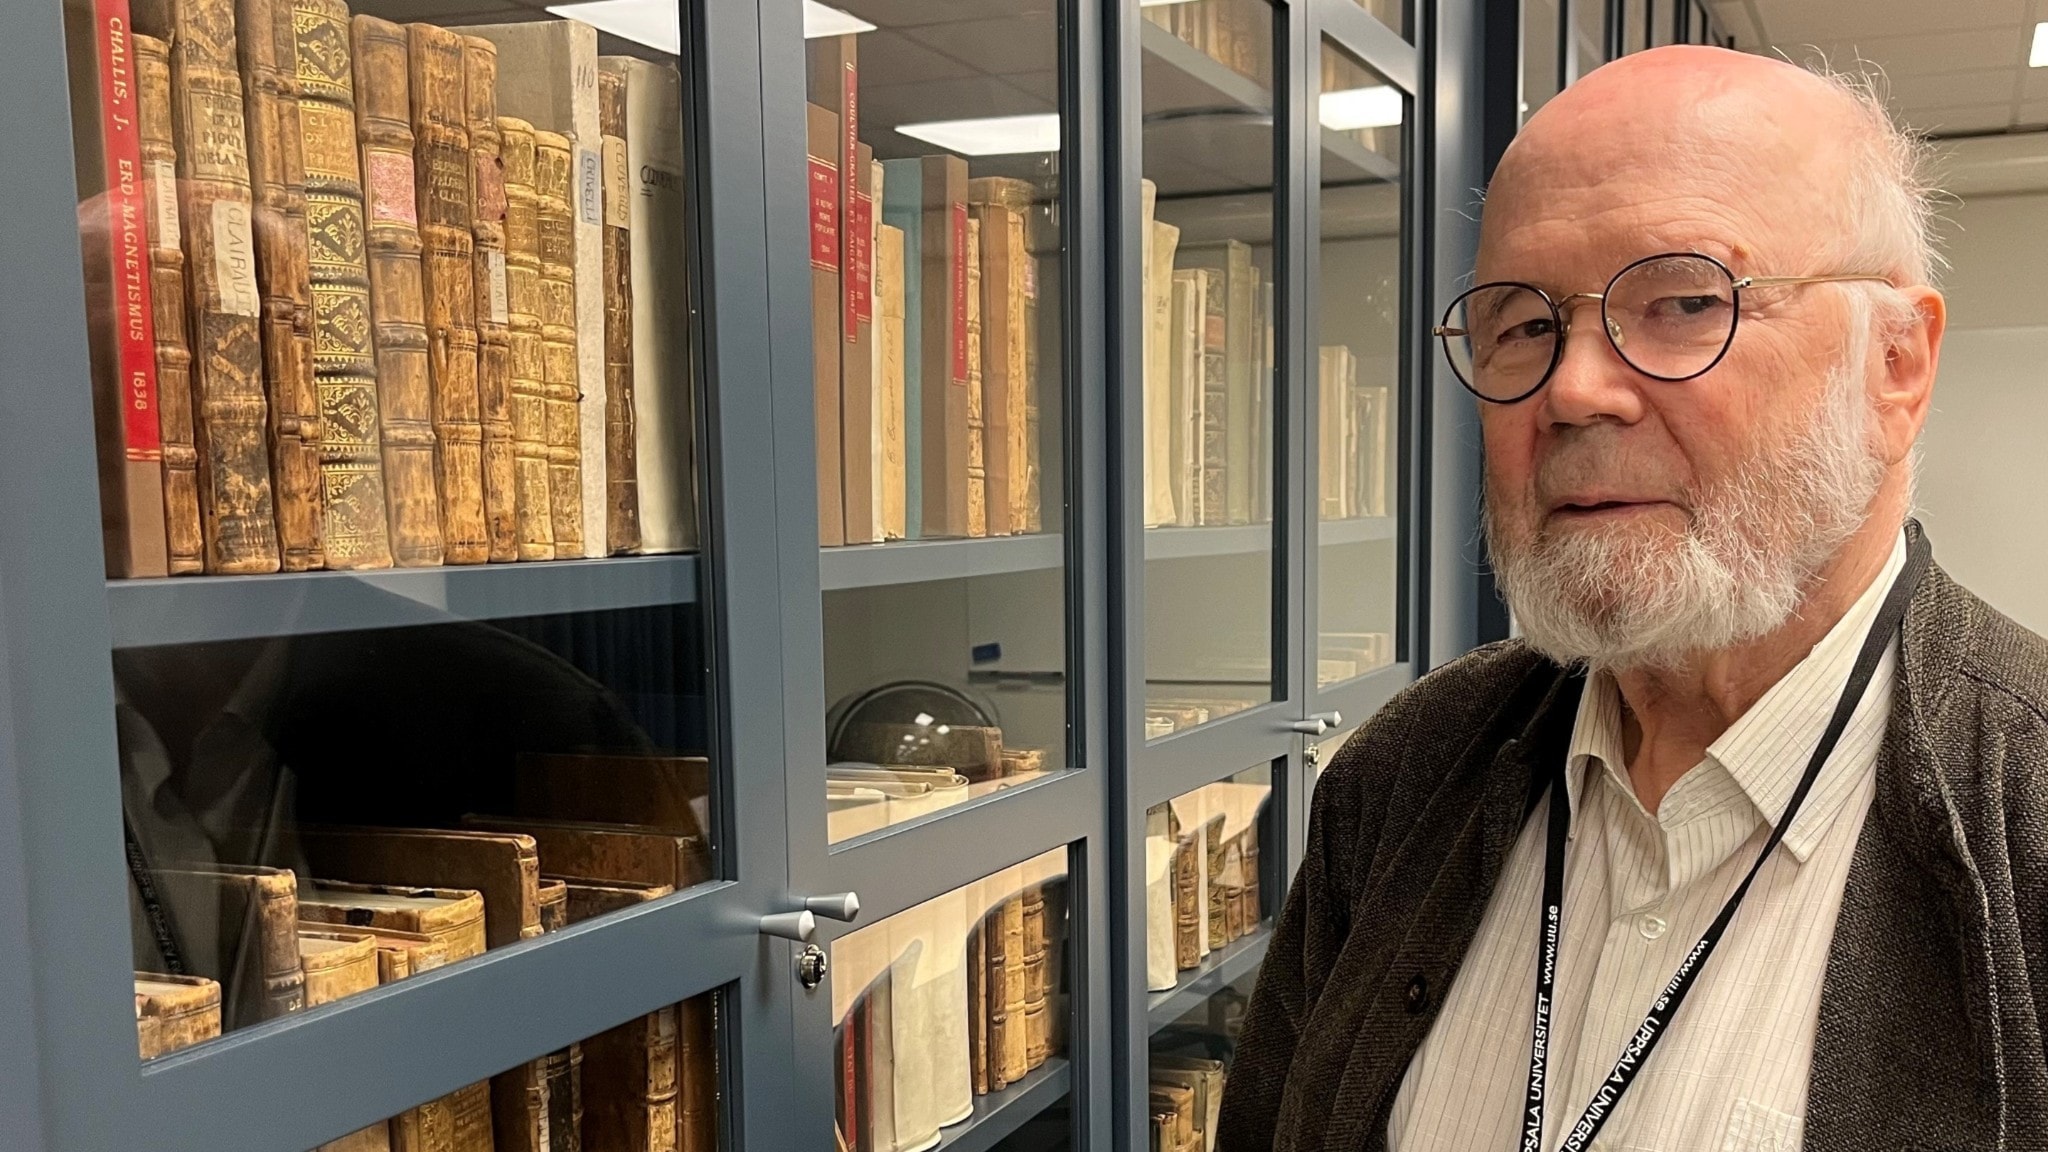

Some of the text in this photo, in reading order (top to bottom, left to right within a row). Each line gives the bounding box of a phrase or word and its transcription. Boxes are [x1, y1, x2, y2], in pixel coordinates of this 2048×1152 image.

[109, 17, 128, 105] CHALLIS,
[113, 114, 129, 131] J.
[133, 371, 148, 410] 1838
[1530, 992, 1550, 1101] UNIVERSITET
[1543, 904, 1559, 985] www.uu.se
[1561, 939, 1709, 1152] www.uu.se UPPSALA UNIVERSI
